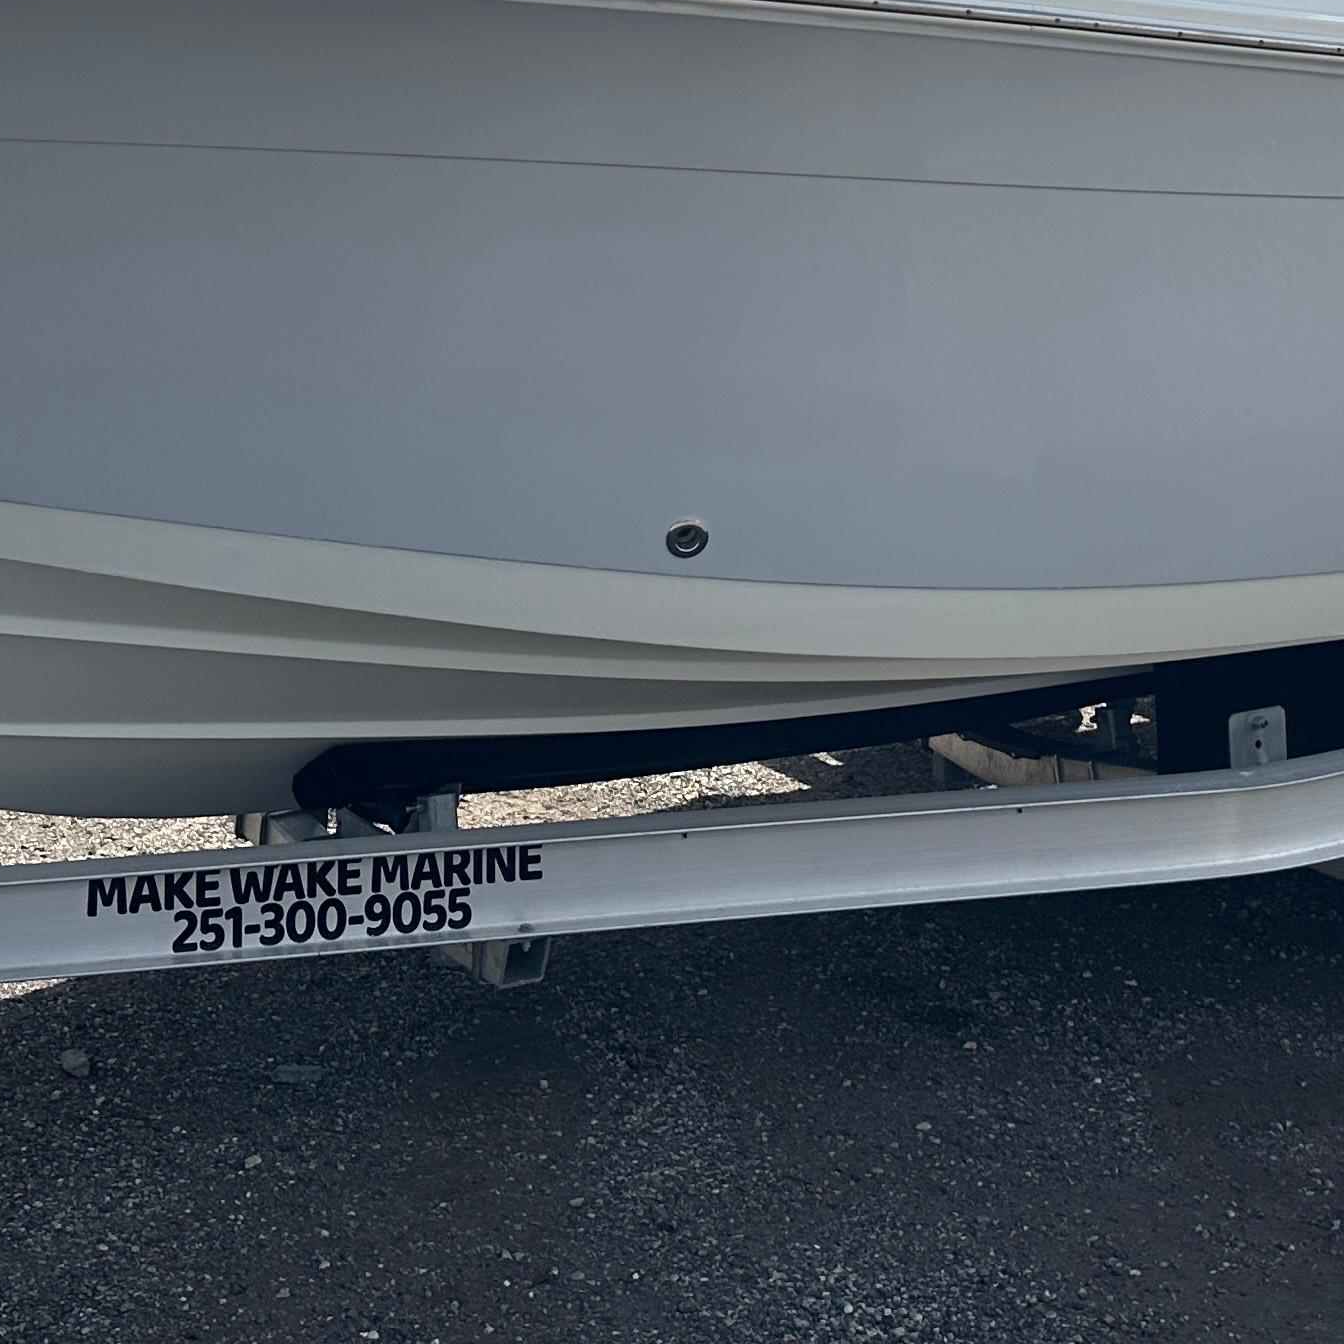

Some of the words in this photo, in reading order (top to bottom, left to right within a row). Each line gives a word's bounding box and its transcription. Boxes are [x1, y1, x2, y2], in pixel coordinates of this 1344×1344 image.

[87, 869, 221, 917] MAKE
[229, 856, 363, 905] WAKE
[371, 843, 544, 893] MARINE
[172, 887, 473, 954] 251-300-9055
